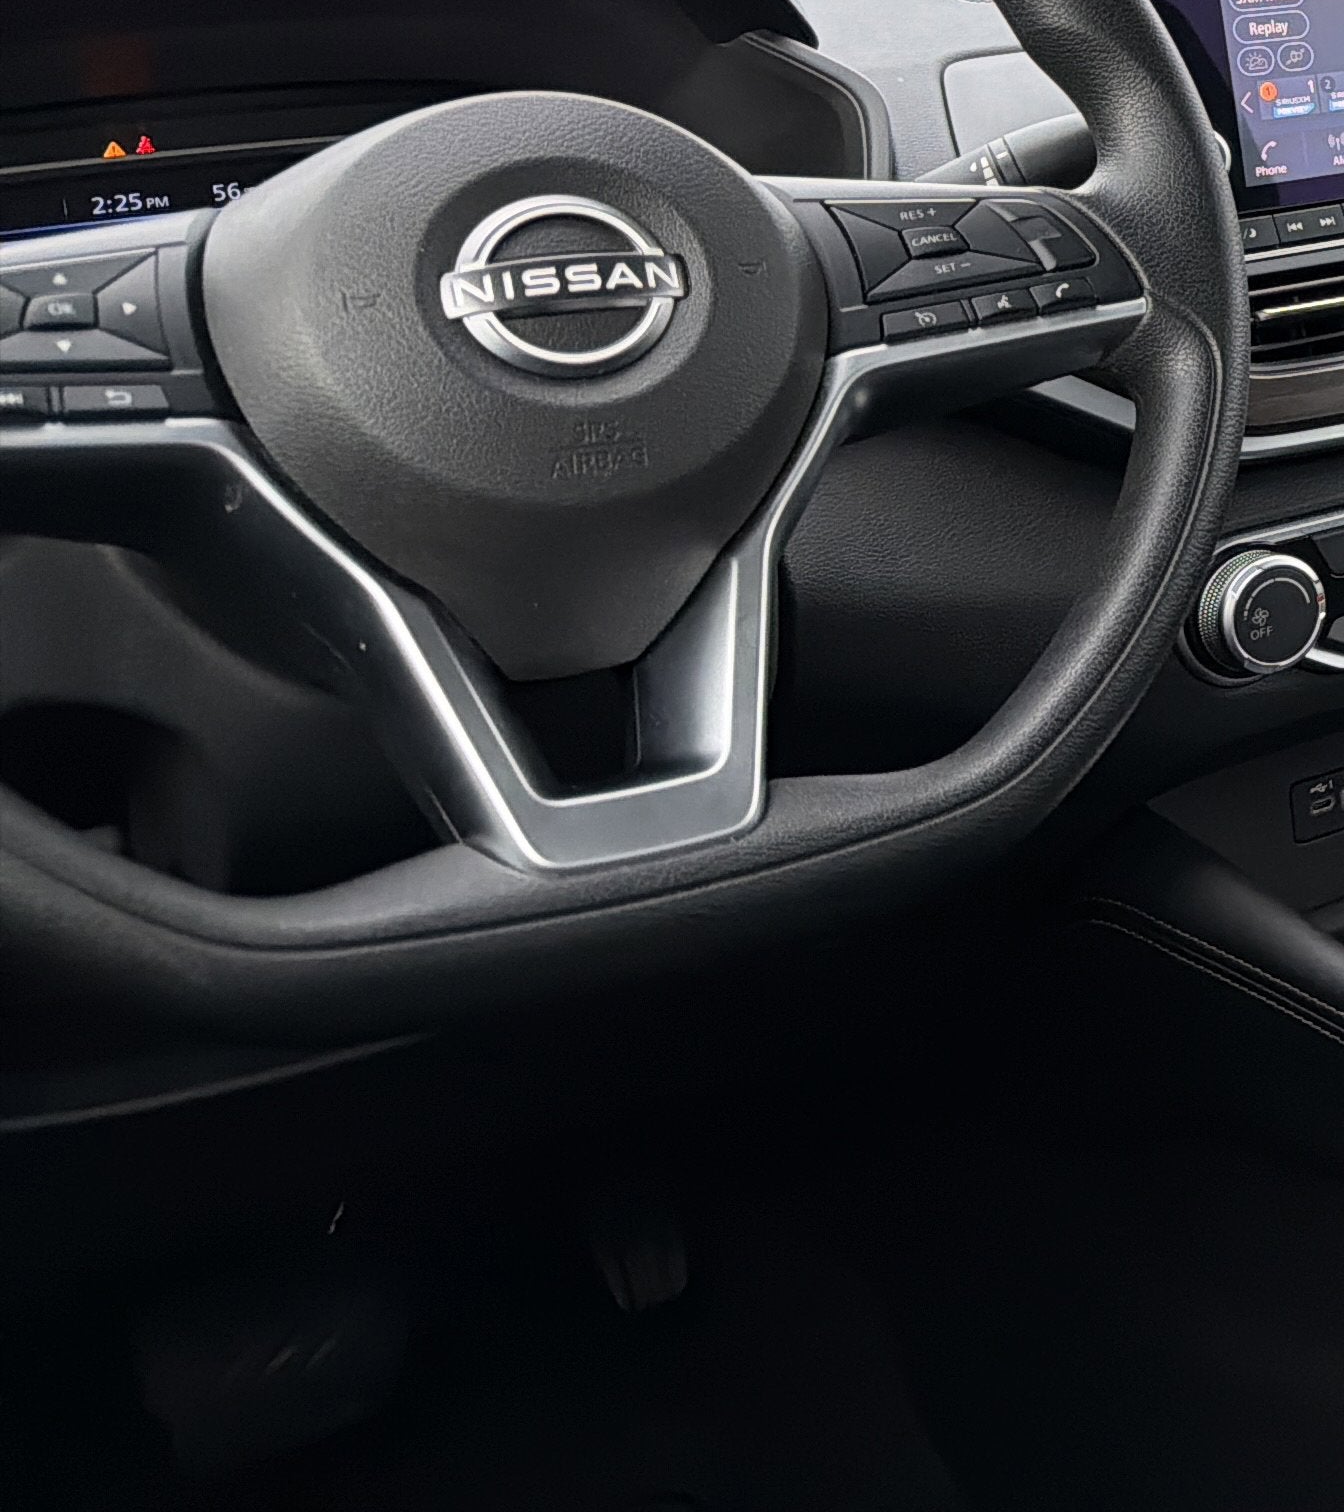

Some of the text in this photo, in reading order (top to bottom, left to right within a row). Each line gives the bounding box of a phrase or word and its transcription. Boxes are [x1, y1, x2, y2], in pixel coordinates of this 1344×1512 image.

[1248, 19, 1289, 38] Replay
[1255, 164, 1288, 177] Phone
[90, 192, 142, 216] 2:25
[146, 195, 170, 209] PM
[899, 209, 925, 221] RES
[911, 233, 958, 247] CANCEL
[934, 262, 956, 275] SET
[454, 262, 681, 307] NISSAN
[1250, 625, 1273, 641] OFF
